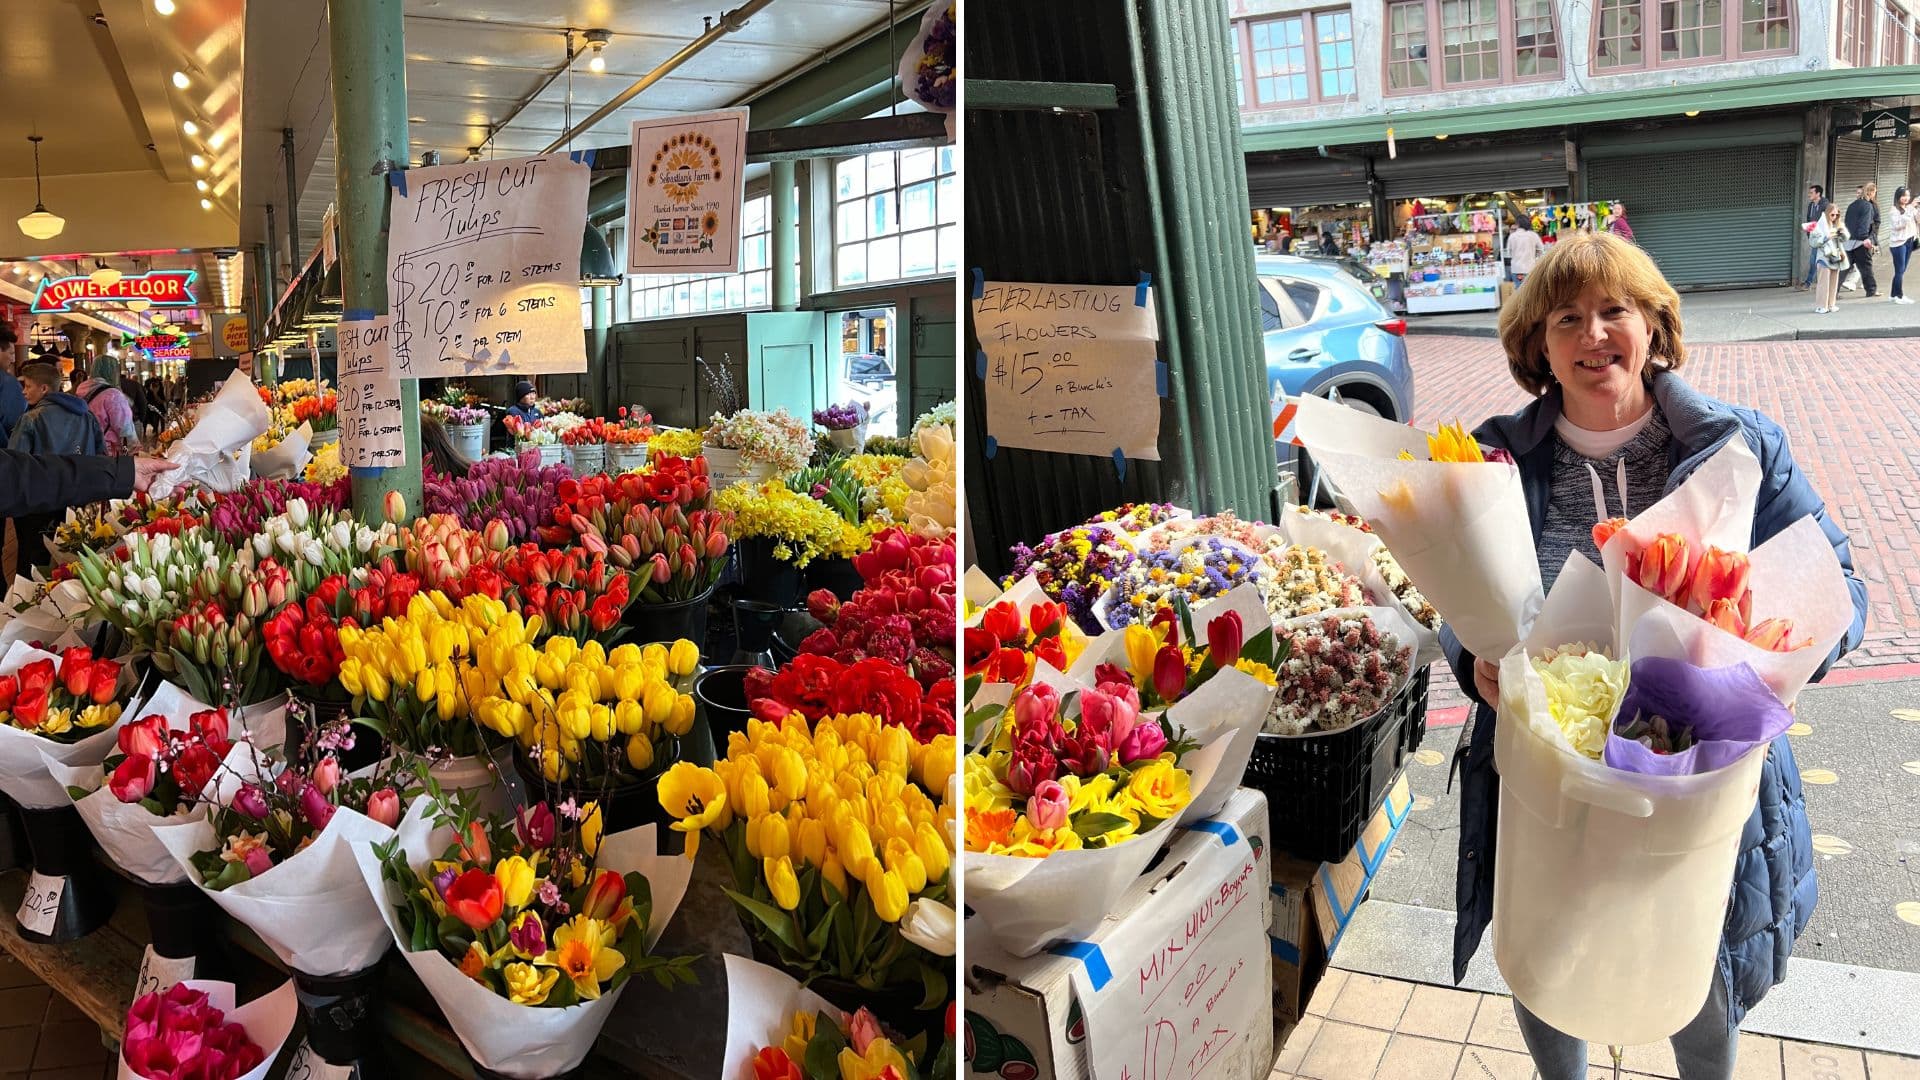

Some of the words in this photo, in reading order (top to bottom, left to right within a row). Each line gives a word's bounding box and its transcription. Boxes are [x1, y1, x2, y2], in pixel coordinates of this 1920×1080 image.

[694, 170, 710, 181] Farm
[415, 167, 489, 223] FRESH
[498, 159, 547, 196] CUT
[440, 203, 501, 242] Tulips
[477, 274, 493, 288] FOR
[500, 270, 511, 284] 12
[522, 262, 562, 277] STEMS
[43, 281, 110, 306] LOWER
[119, 279, 179, 296] FLOOR
[978, 286, 1121, 314] EVERLASTING
[475, 307, 493, 322] FOR
[499, 302, 507, 316] 6
[517, 297, 556, 312] STEMS
[363, 326, 389, 346] CUT
[495, 329, 522, 345] STEM
[994, 322, 1097, 347] FLOWERS
[344, 352, 373, 374] Tulips
[1055, 384, 1063, 395] A
[1060, 407, 1096, 422] TAX
[373, 427, 379, 436] 6
[1140, 937, 1184, 995] MIX
[1187, 1024, 1229, 1076] TAX
